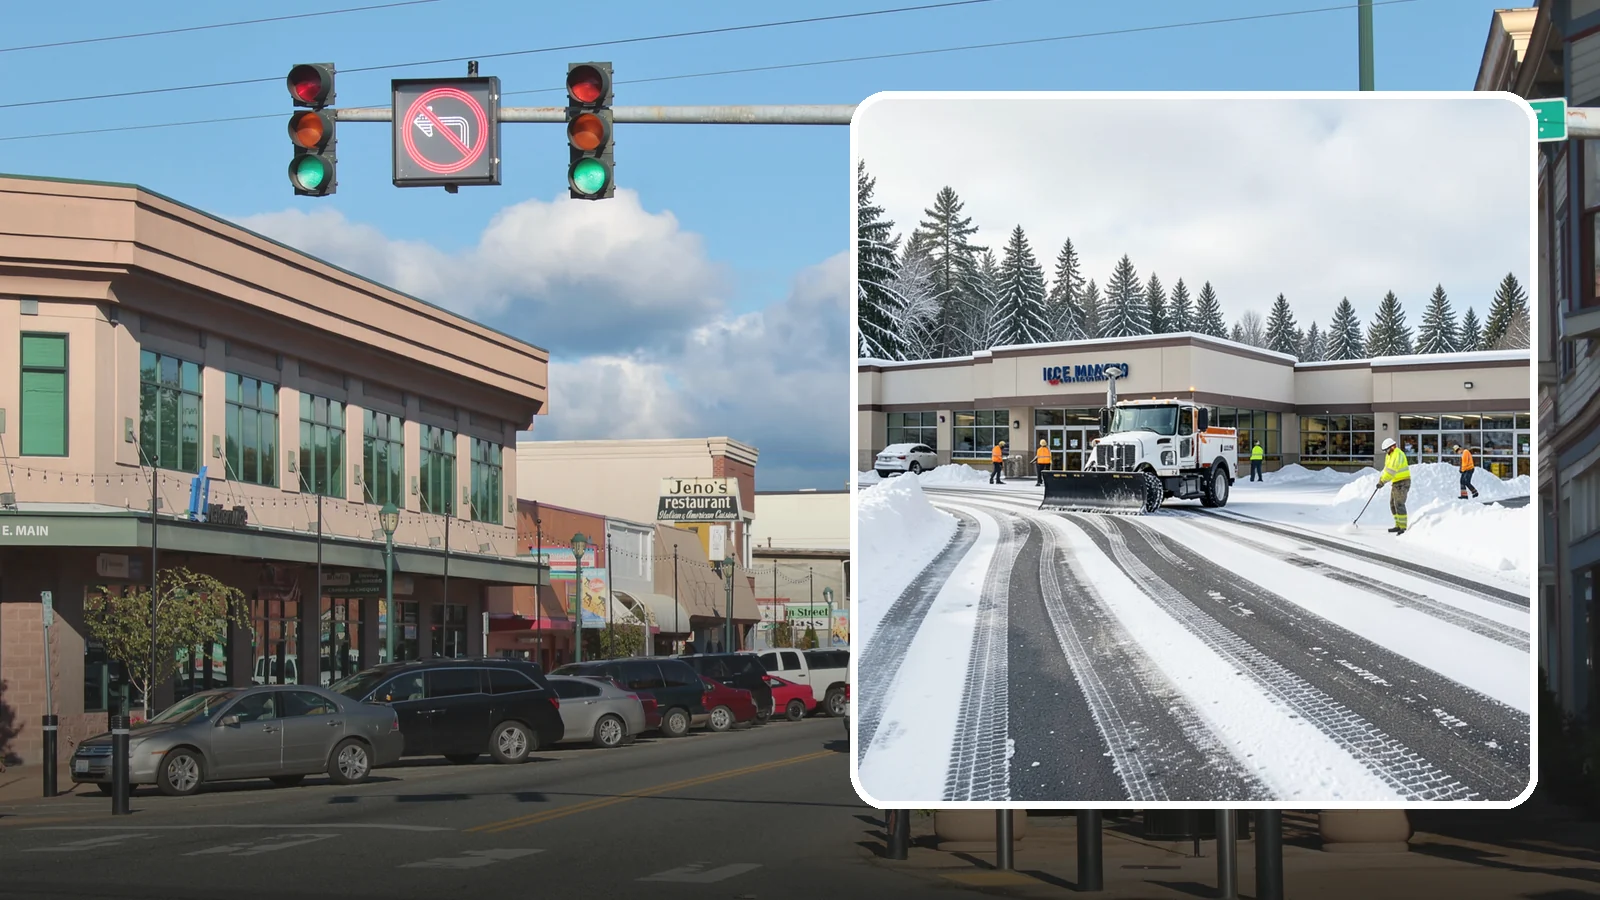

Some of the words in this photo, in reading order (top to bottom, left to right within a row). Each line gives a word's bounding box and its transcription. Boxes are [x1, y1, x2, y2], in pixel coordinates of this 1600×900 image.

[670, 480, 728, 495] Jeno's
[665, 496, 731, 509] restaurant
[658, 509, 681, 519] Italian
[686, 509, 715, 519] American
[715, 509, 738, 519] Cuisine
[2, 525, 13, 536] E.
[15, 525, 49, 536] MAIN
[797, 607, 828, 617] Street
